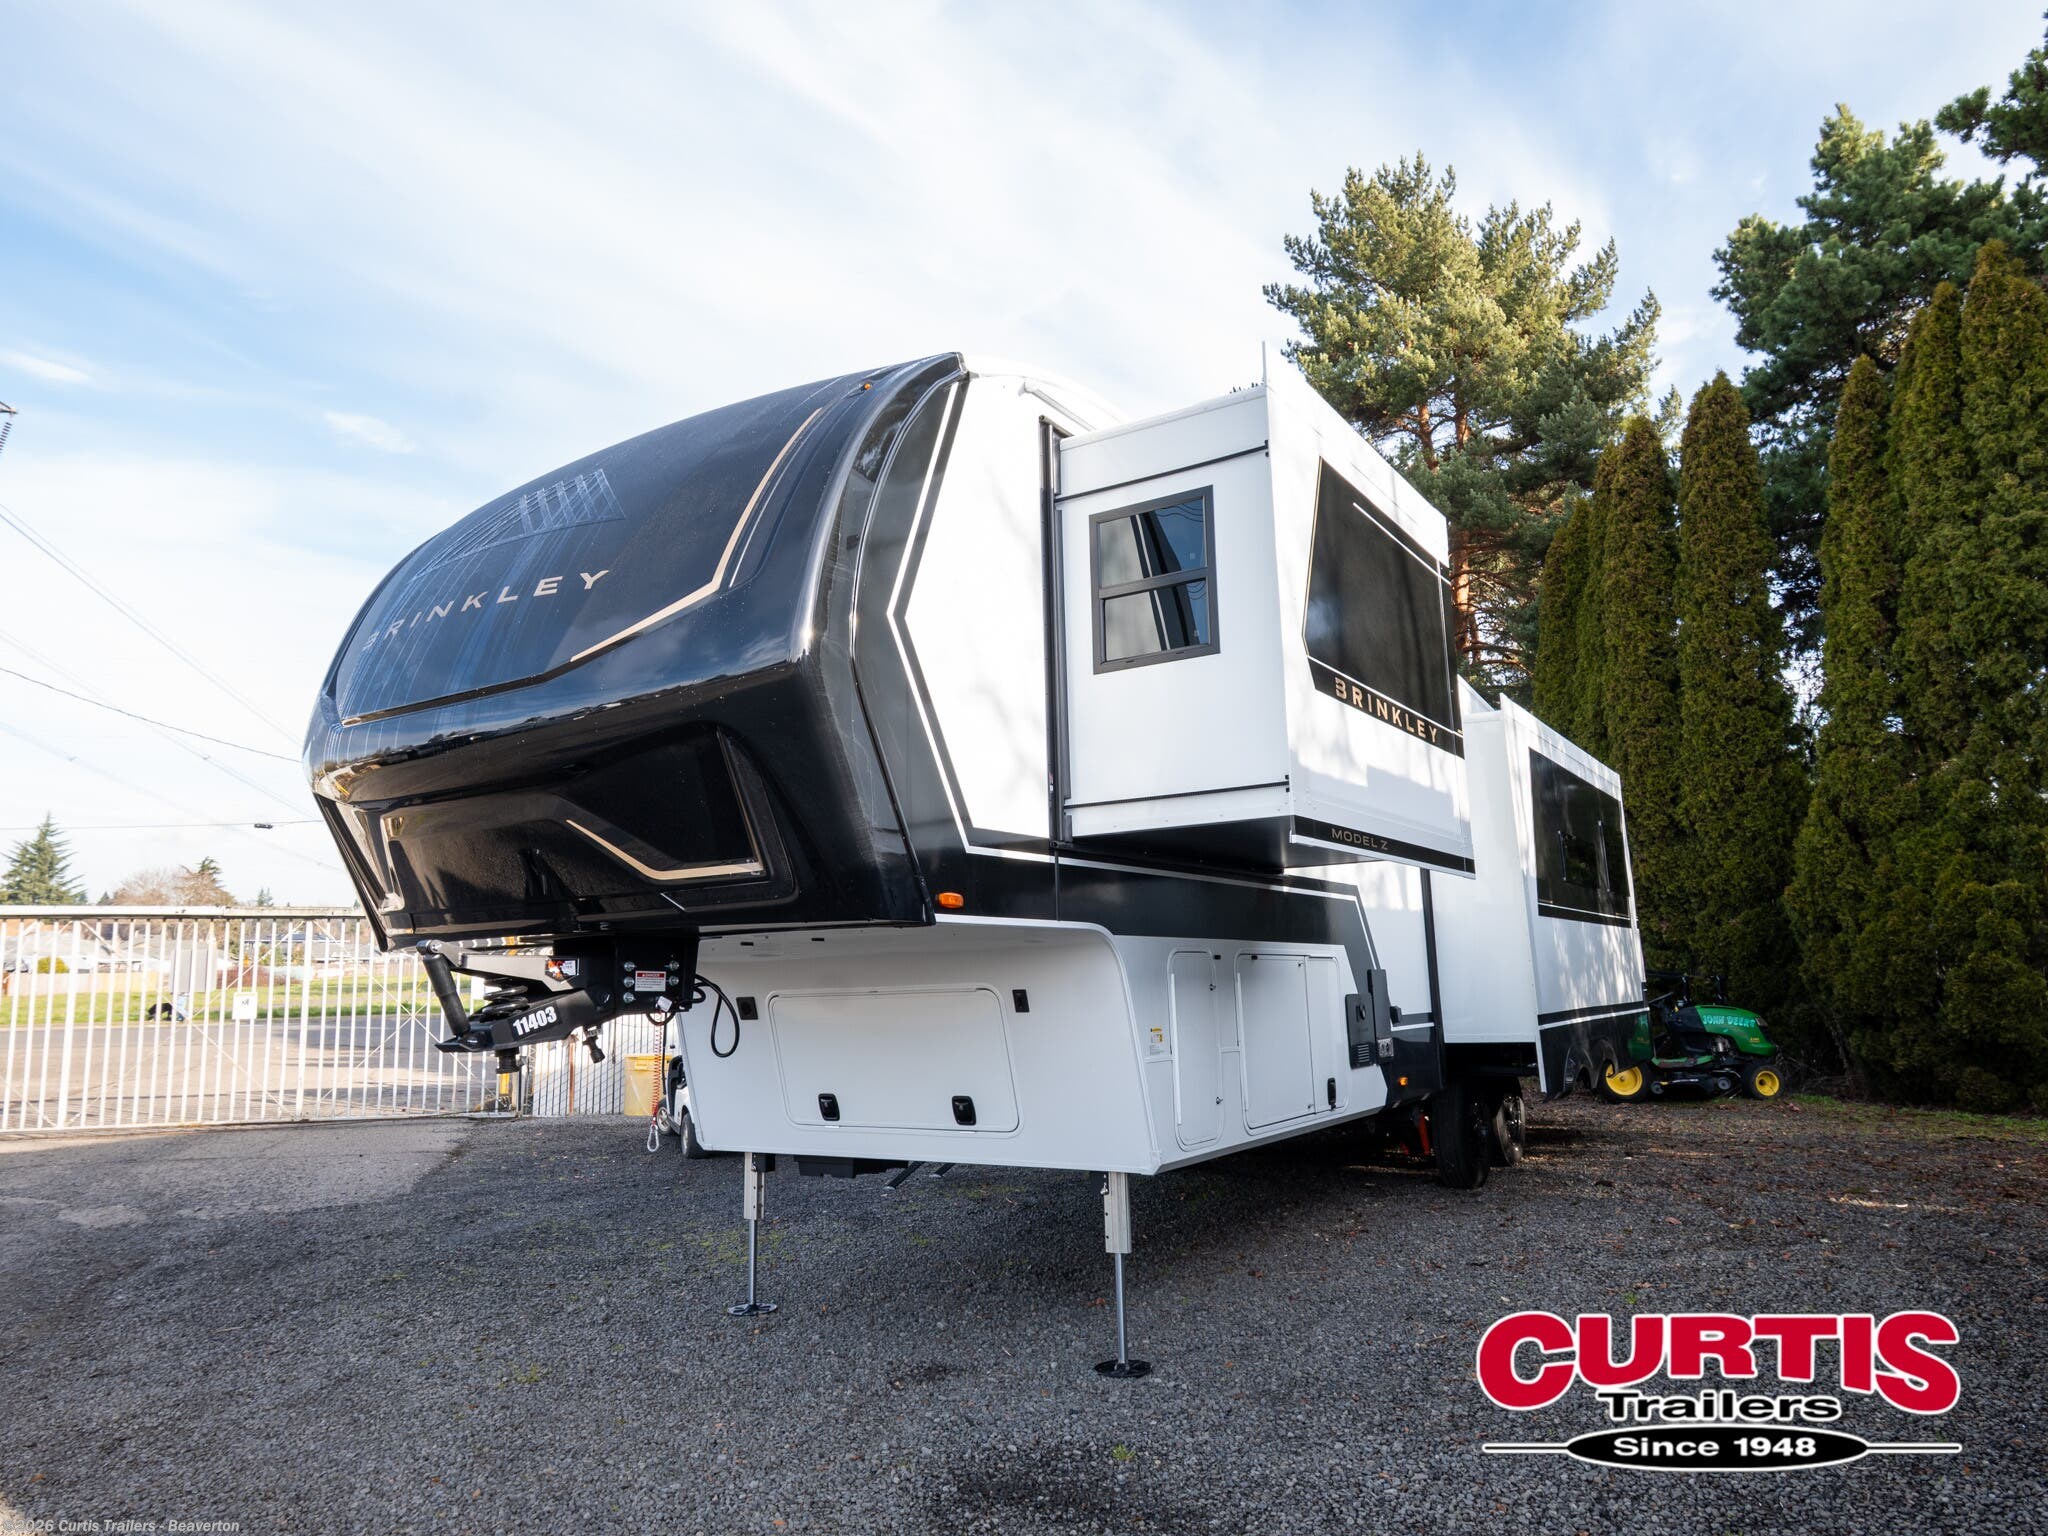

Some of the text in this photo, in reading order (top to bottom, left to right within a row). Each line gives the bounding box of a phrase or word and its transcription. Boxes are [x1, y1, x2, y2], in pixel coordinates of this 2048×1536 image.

[361, 570, 609, 651] BRINKLEY
[1335, 677, 1437, 743] BRINKLEY
[1331, 828, 1389, 850] MODEL Z
[513, 1006, 557, 1036] 11403
[1702, 1014, 1756, 1028] JOHN DEERE
